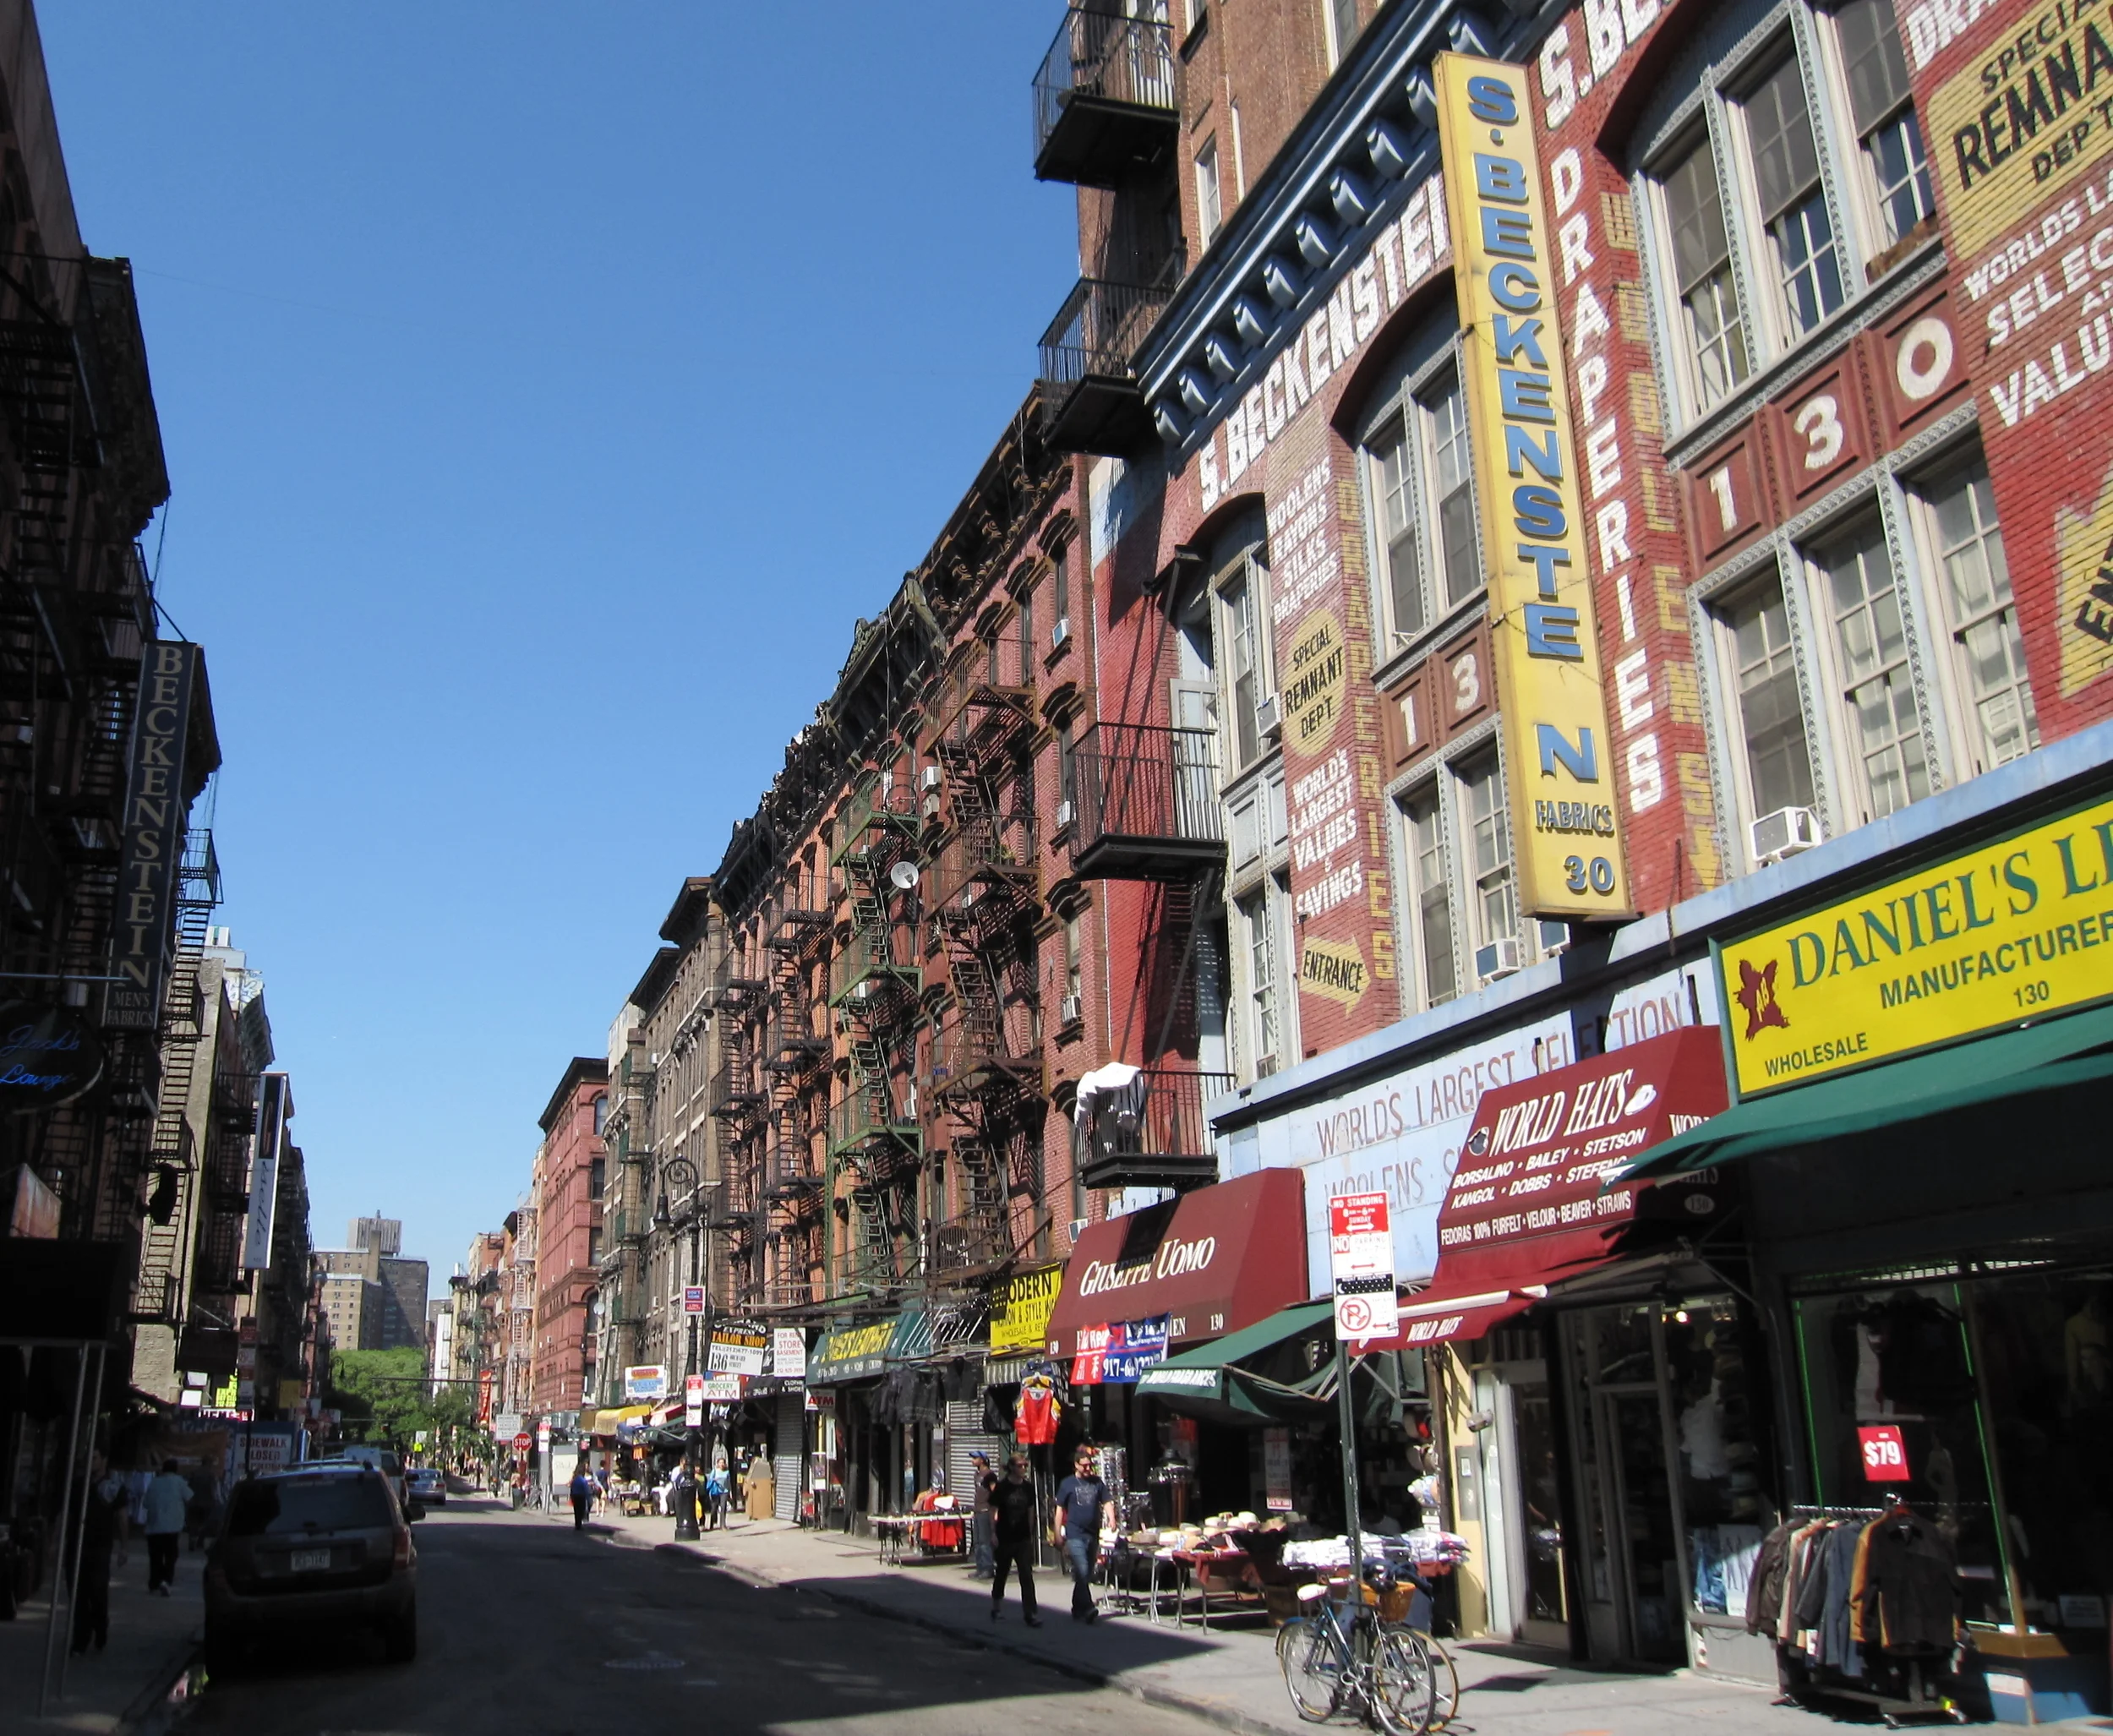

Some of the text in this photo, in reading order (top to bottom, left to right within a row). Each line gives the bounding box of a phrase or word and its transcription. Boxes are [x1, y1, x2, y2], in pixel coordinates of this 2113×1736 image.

[1953, 4, 2113, 192] REMNA
[1989, 308, 2113, 427] VALU
[1267, 455, 1331, 538] WOOLENS
[1550, 146, 1663, 815] DRAPERIES
[1274, 494, 1328, 566] RAYONS
[1283, 527, 1327, 589] SILKS
[1273, 551, 1338, 625] DRAPERIES
[1293, 624, 1332, 672] SPECIAL
[1285, 646, 1343, 718] REMNANT
[1400, 652, 1481, 746] 13
[1291, 748, 1350, 807] WORLD'S
[113, 646, 183, 988] BECKENSTEIN
[1291, 775, 1353, 838] LARGEST
[1535, 799, 1614, 834] FABRICS
[1293, 808, 1357, 871] VALUES
[1296, 860, 1363, 918] SAVINGS
[1787, 849, 2039, 990] DANIEL'S
[1302, 949, 1363, 994] ENTRANCE
[2013, 980, 2050, 1007] 130
[106, 1010, 156, 1026] FABRICS
[113, 991, 151, 1007] MEN'S
[1764, 1032, 1869, 1078] WHOLESALE
[1489, 1068, 1634, 1157] WORLD HATS
[1452, 1160, 1514, 1189] BORSALINO
[1525, 1146, 1571, 1171] BAILEY
[1583, 1127, 1647, 1157] STETSON
[1333, 1195, 1384, 1208] NO STANDING
[1451, 1187, 1495, 1209] KANGOL
[1509, 1173, 1553, 1197] DOBBS
[1348, 1215, 1372, 1224] SUNDAY
[1441, 1190, 1632, 1246] FEDORAS 100% FURFELT VELOUR BEAVER STRAWS
[1156, 1236, 1216, 1280] UOMO
[1334, 1237, 1351, 1253] NO
[1006, 1272, 1052, 1306] ODERN
[712, 1331, 767, 1348] TAILOR SHOP
[723, 1326, 756, 1336] EXPRESS
[778, 1340, 801, 1349] STORE
[1002, 1324, 1027, 1338] WHOLESALE
[1210, 1313, 1225, 1331] 130
[710, 1352, 728, 1372] 136
[808, 1395, 834, 1406] ATM
[239, 1437, 287, 1447] SDEWALK
[514, 1438, 532, 1447] STOP
[1865, 1440, 1902, 1467] $79
